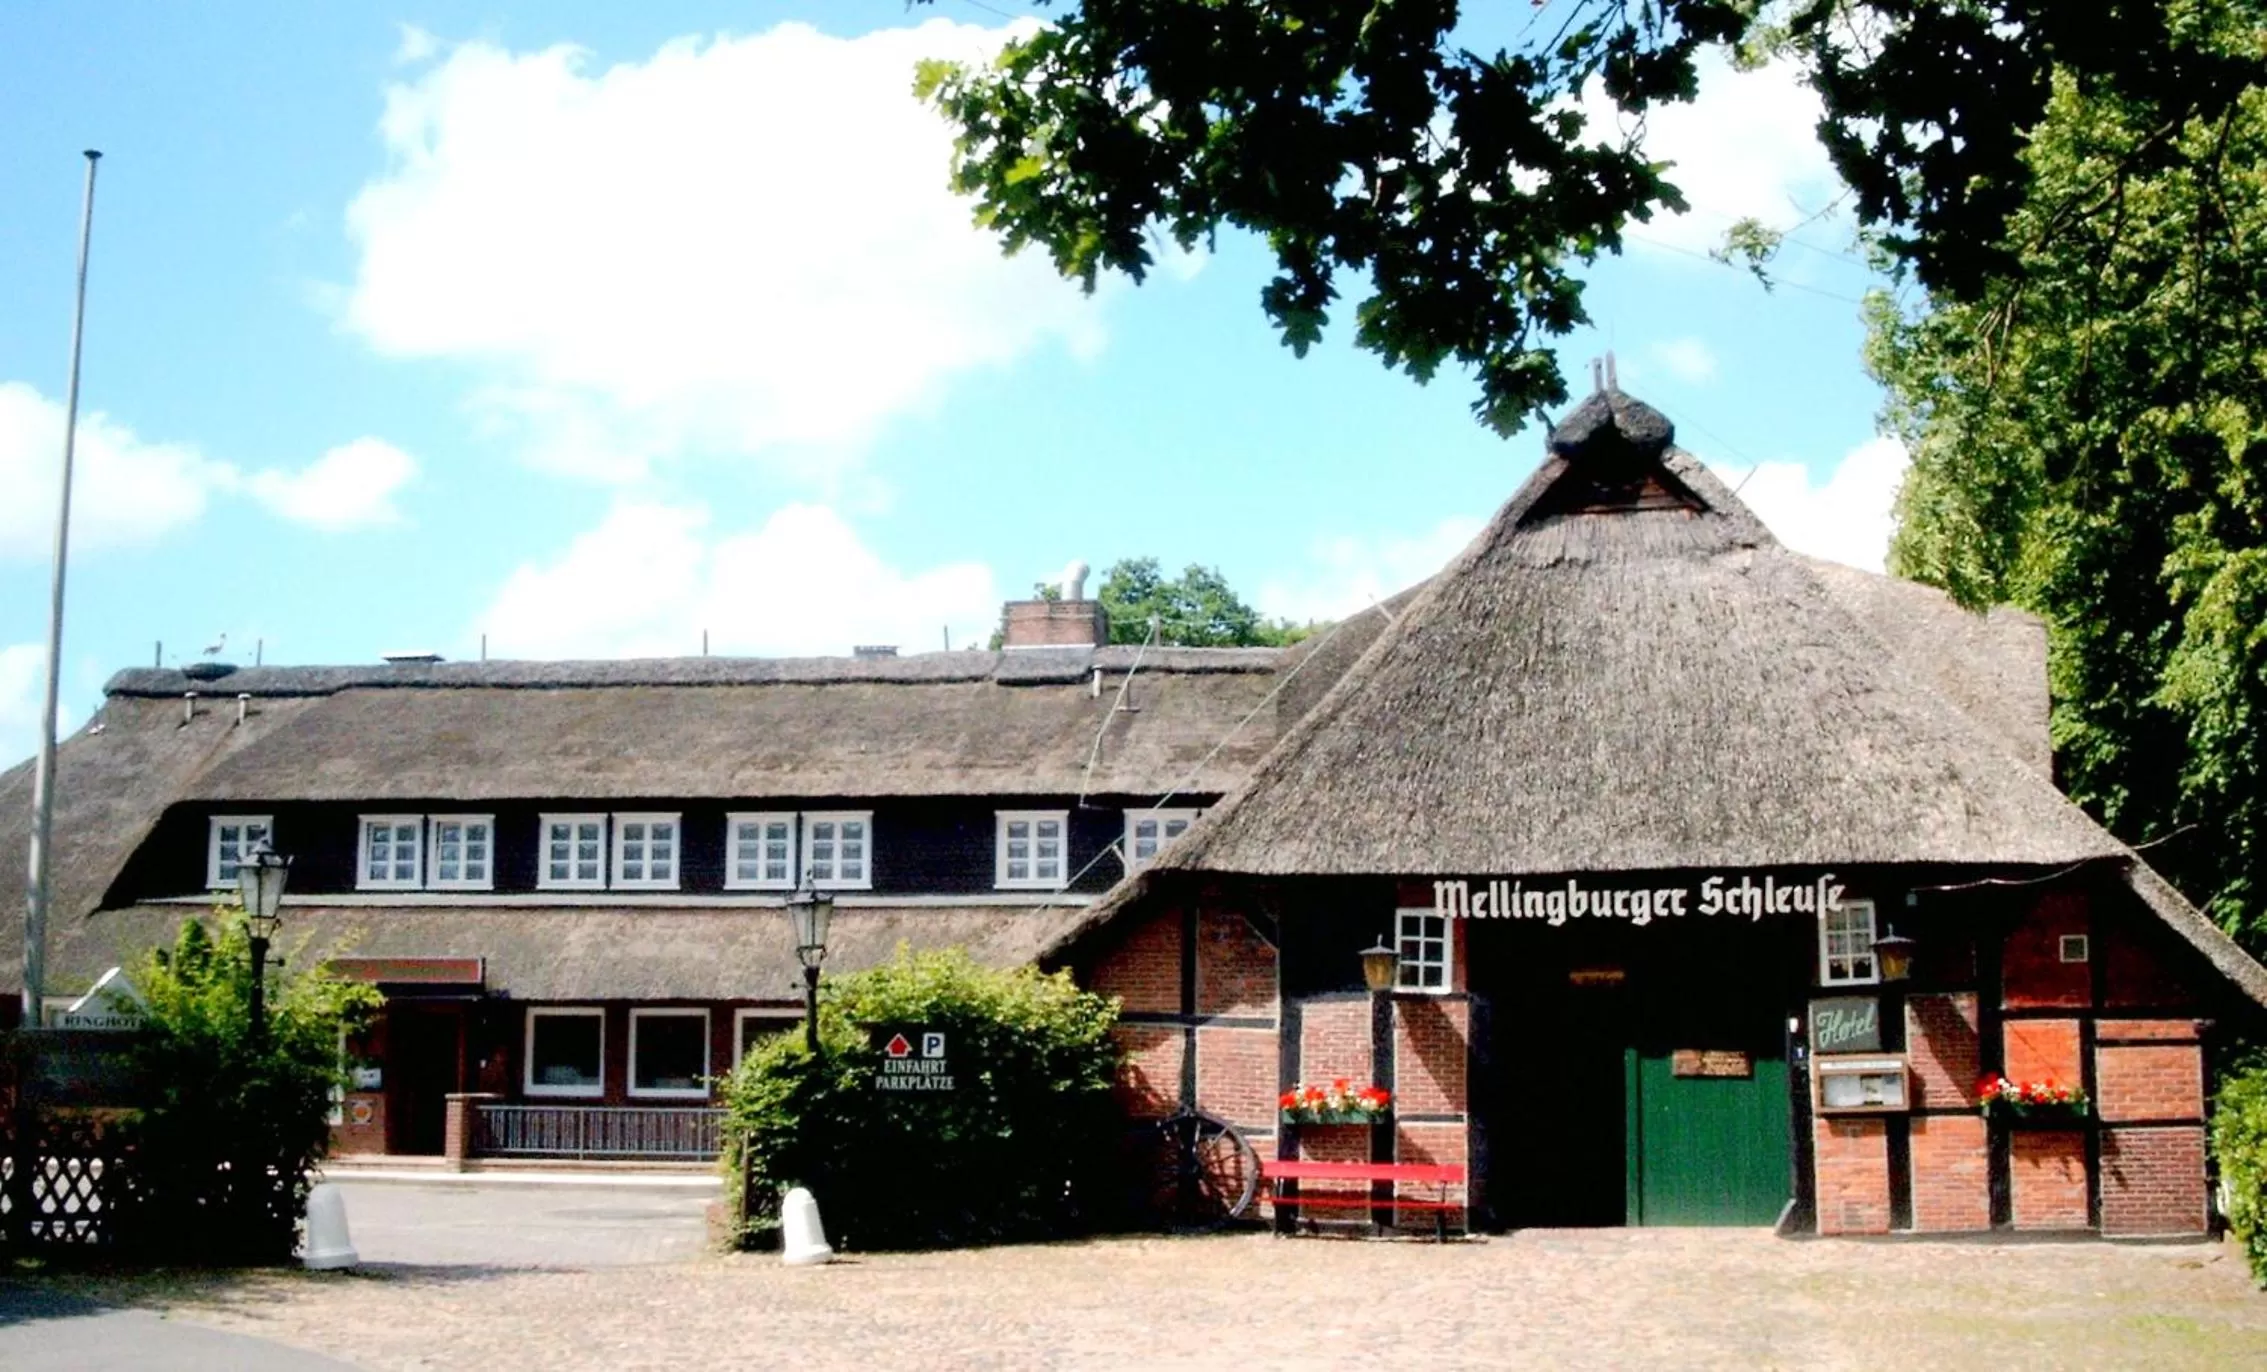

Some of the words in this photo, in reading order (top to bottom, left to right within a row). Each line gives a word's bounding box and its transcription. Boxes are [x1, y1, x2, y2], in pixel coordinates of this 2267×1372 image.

[1432, 880, 1688, 927] Mellingburger
[1816, 1002, 1876, 1048] Hotel
[926, 1035, 940, 1055] P
[884, 1059, 947, 1074] EINFAHRT
[875, 1073, 956, 1091] PARKPLÄTZE
